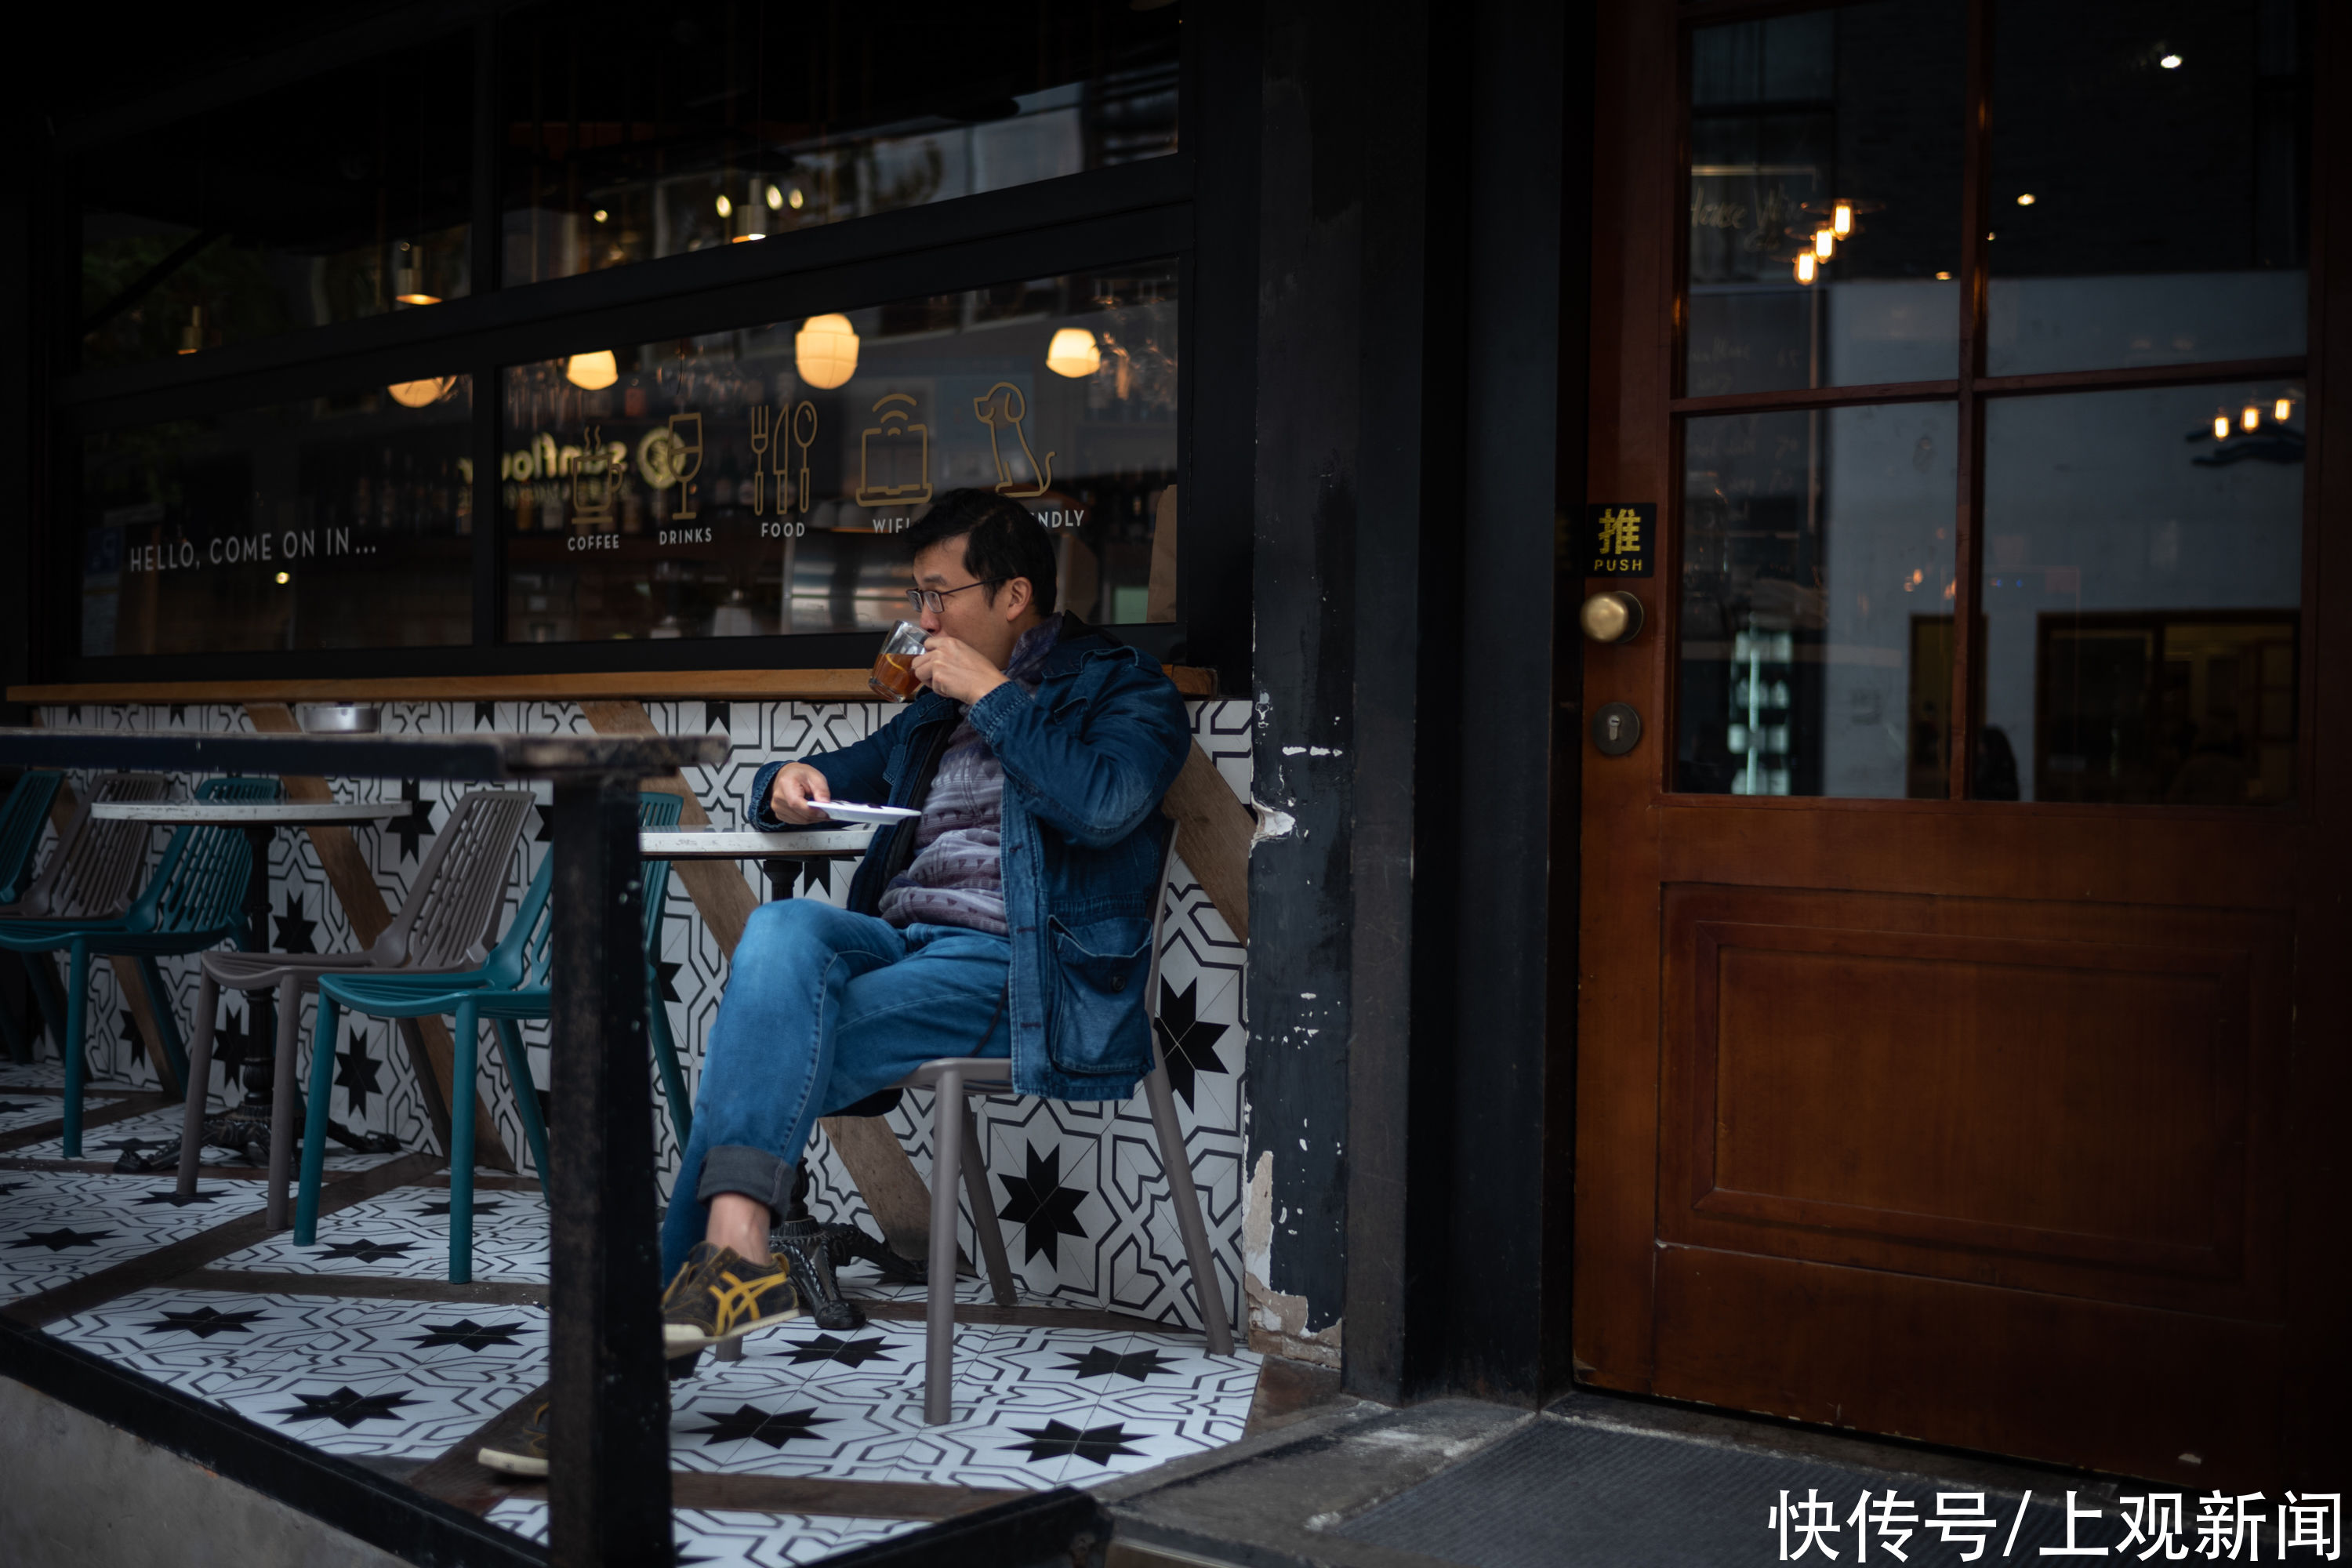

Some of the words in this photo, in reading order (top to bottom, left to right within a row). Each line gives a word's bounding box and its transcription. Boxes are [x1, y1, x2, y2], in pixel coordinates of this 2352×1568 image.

[1029, 510, 1084, 528] NDLY
[659, 527, 713, 546] DRINKS
[760, 522, 806, 538] FOOD
[1599, 508, 1641, 554] 推
[130, 542, 200, 572] HELLO,
[209, 532, 272, 564] COME
[282, 529, 315, 559] ON
[568, 534, 620, 552] COFFEE
[1594, 559, 1642, 571] PUSH
